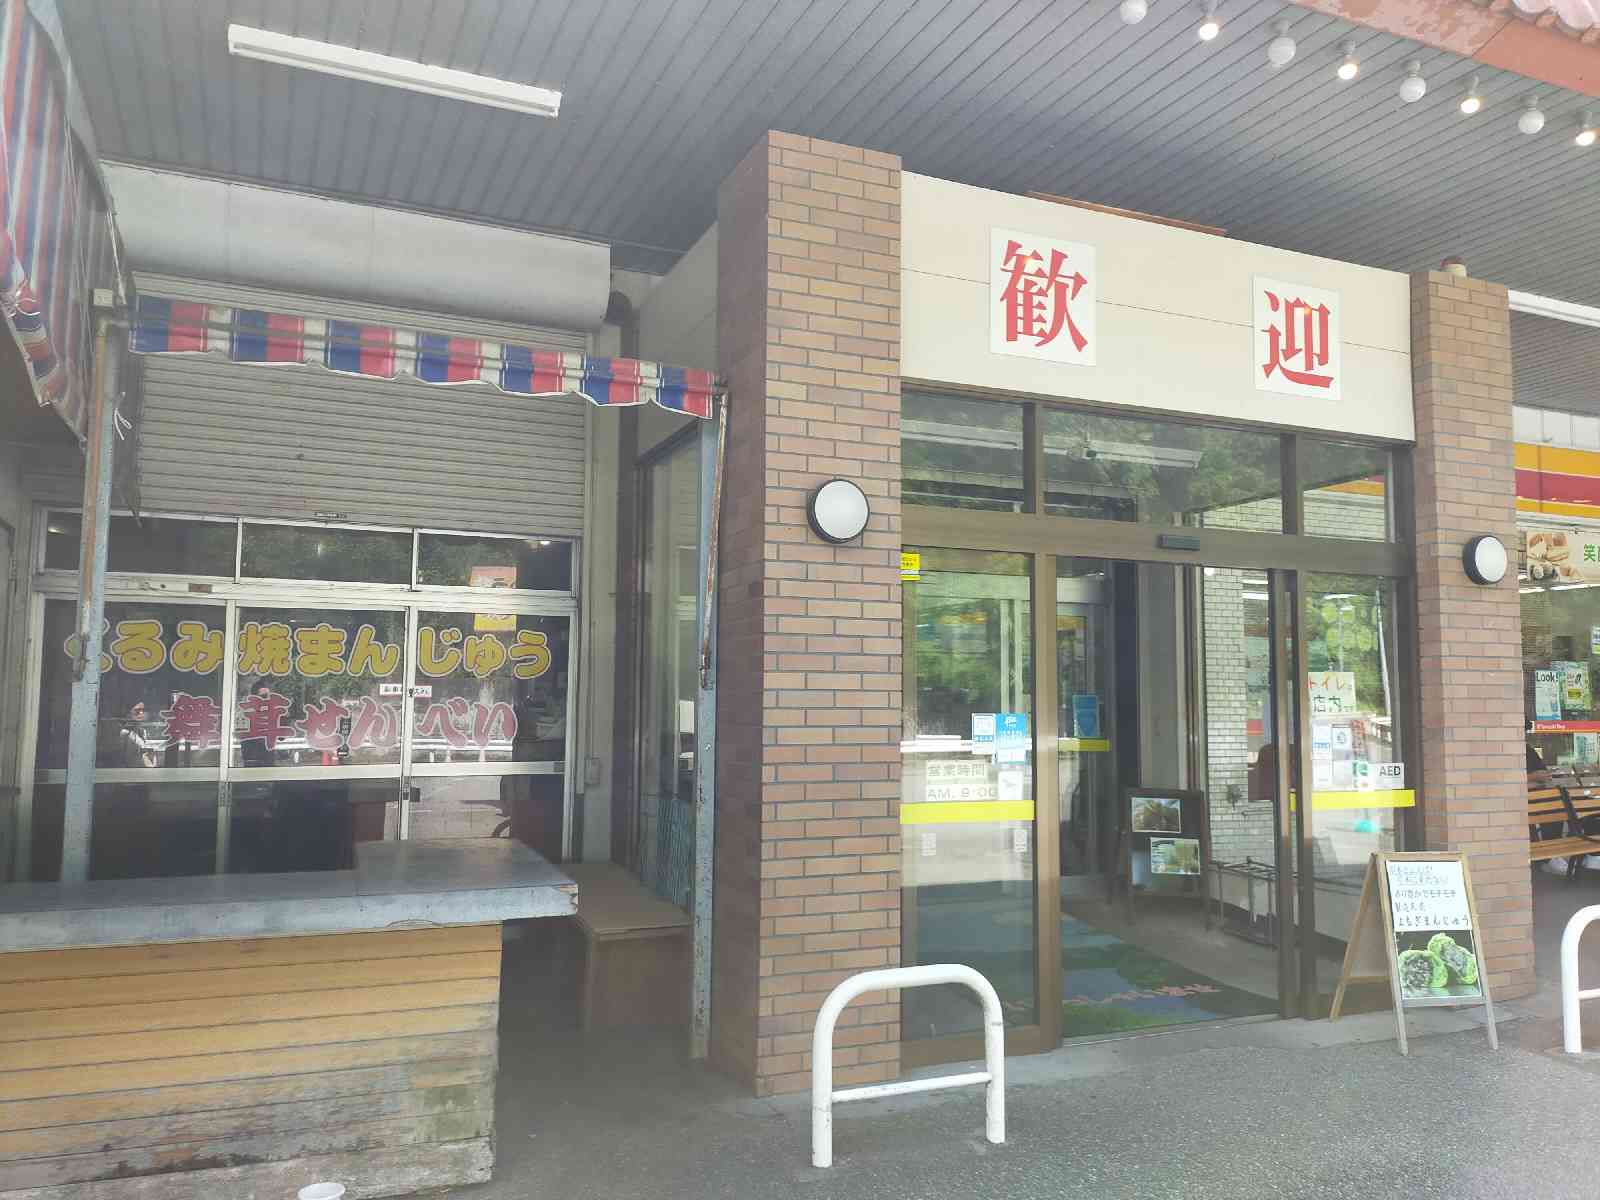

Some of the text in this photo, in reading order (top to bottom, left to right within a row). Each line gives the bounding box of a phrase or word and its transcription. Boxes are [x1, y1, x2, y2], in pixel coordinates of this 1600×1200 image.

[999, 239, 1335, 389] 歓 迎
[1536, 671, 1559, 683] Look!
[160, 690, 518, 751] 舞茸せんべい
[928, 762, 985, 777] 営業時間
[1379, 766, 1401, 777] AED
